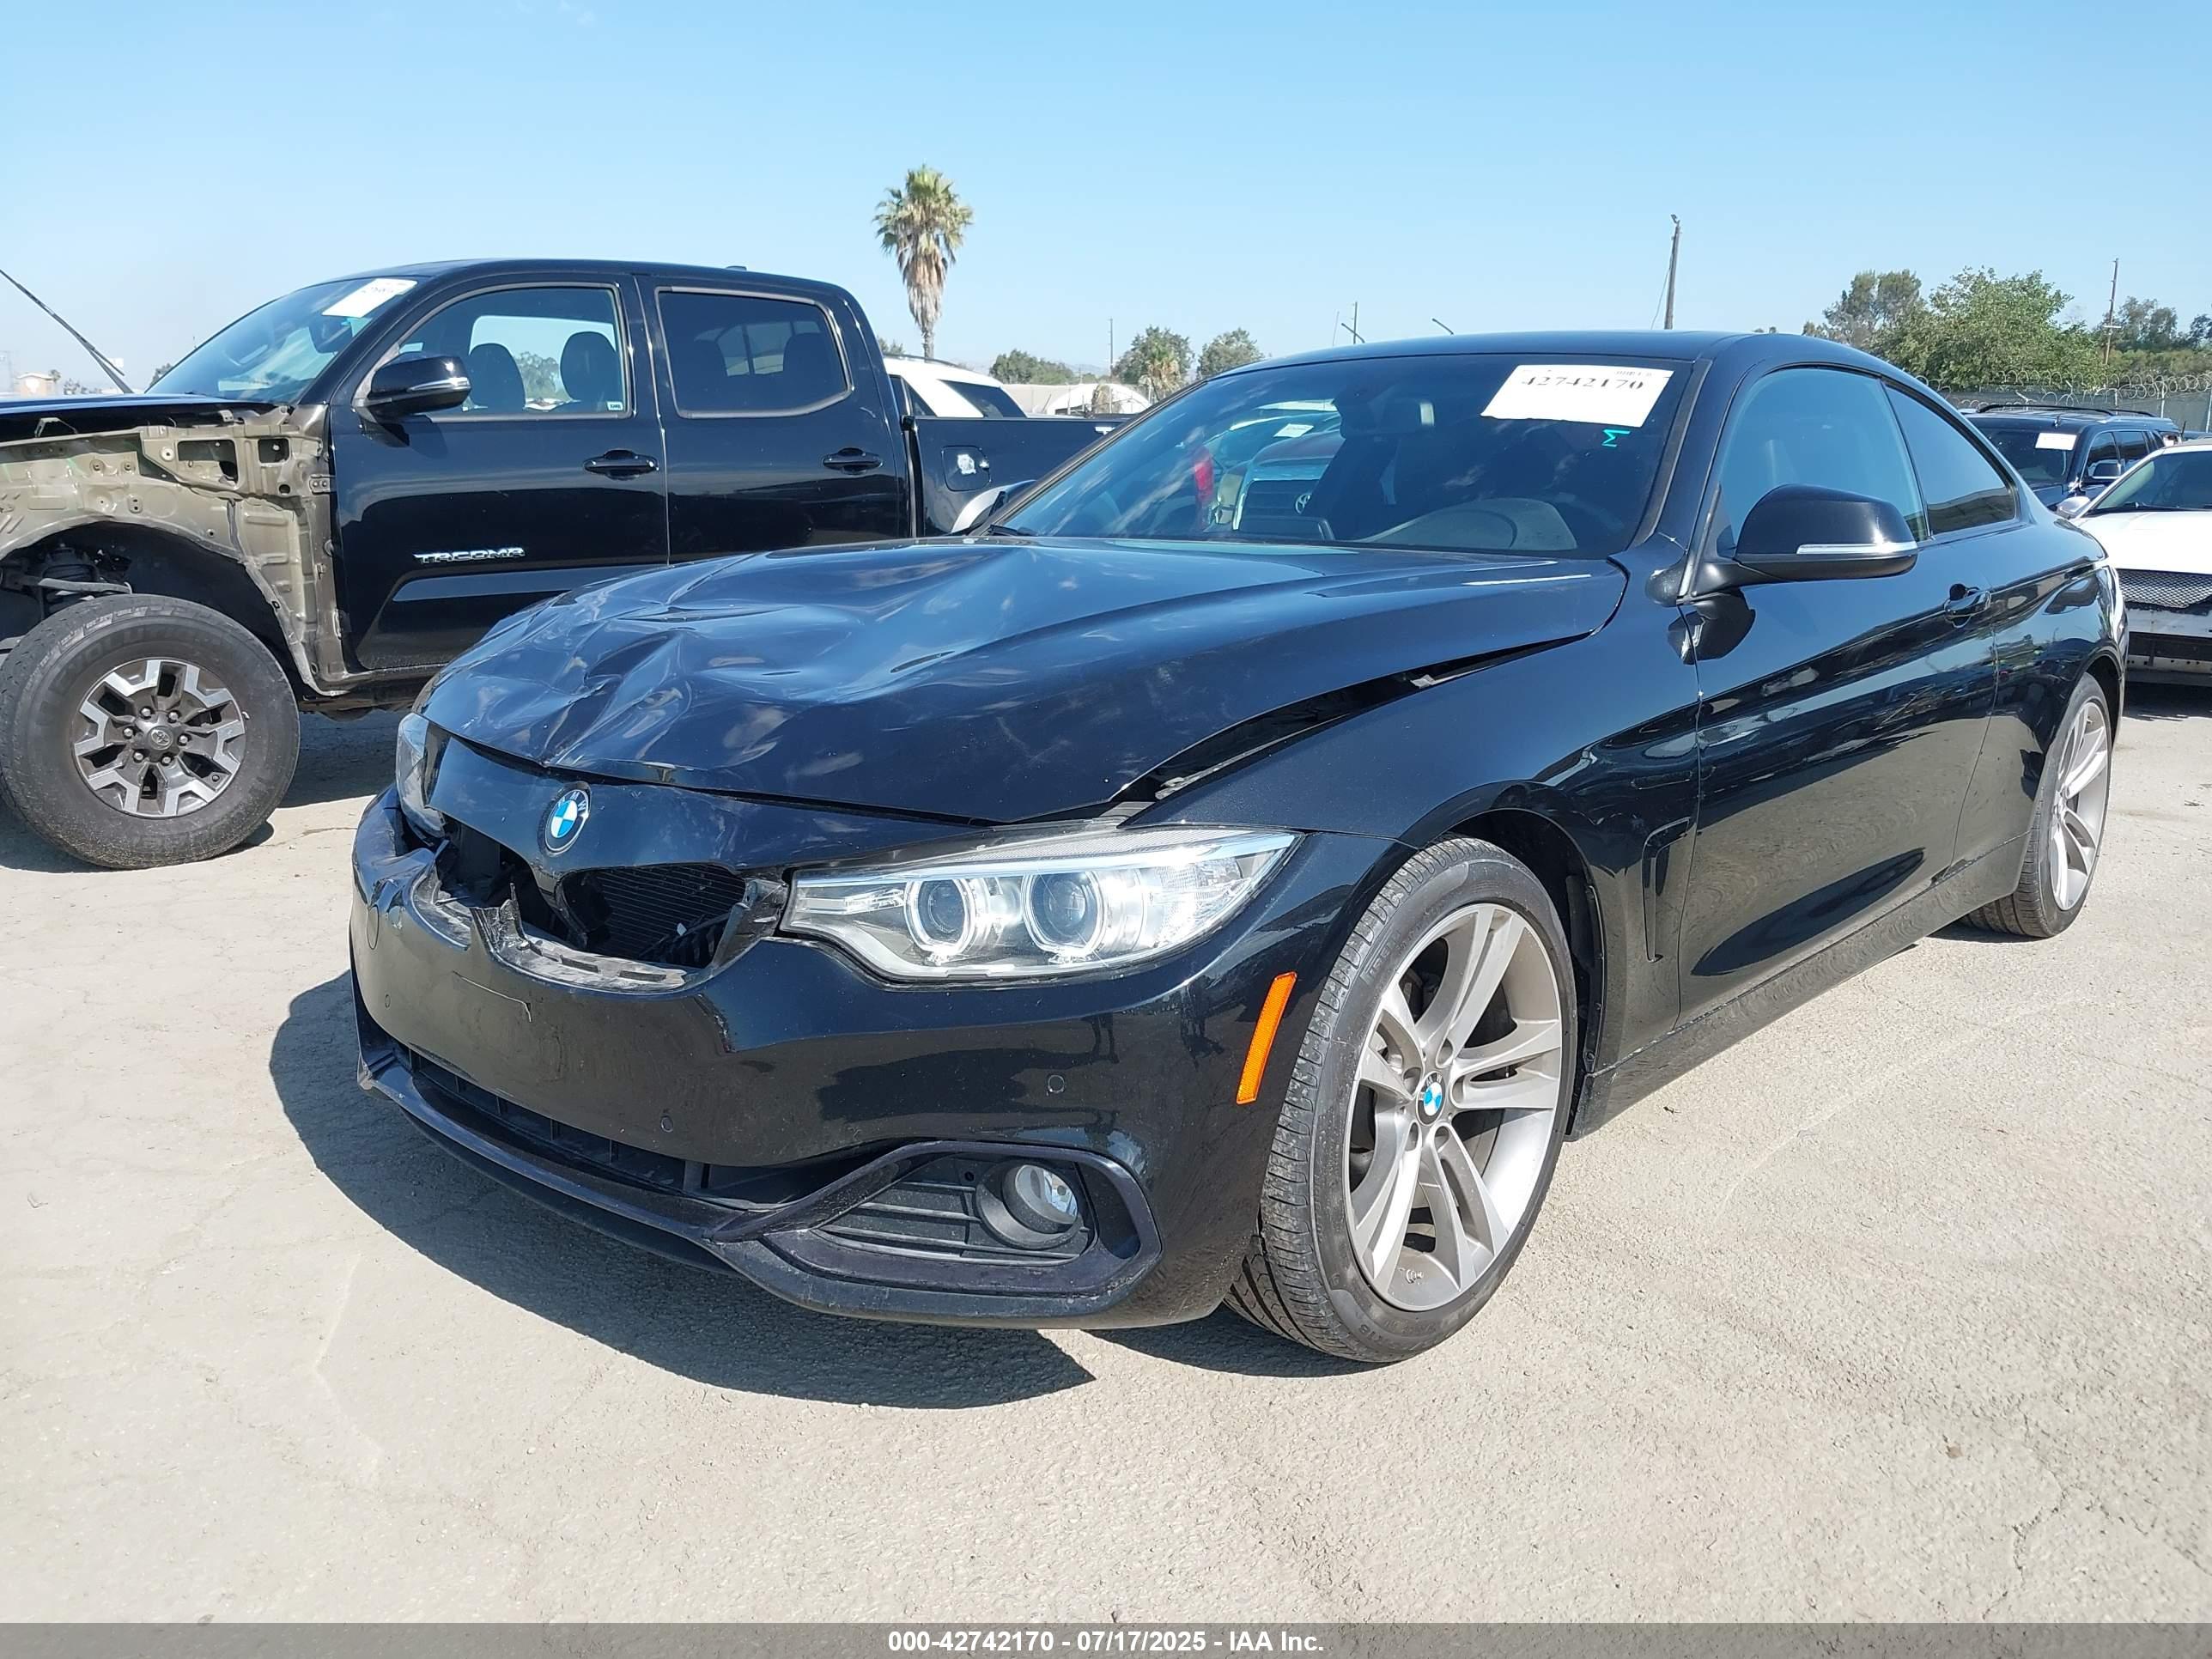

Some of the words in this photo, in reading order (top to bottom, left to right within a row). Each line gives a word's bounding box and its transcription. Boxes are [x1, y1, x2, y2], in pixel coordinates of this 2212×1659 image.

[412, 547, 526, 564] TACOMA
[557, 791, 587, 813] BMW
[1419, 1073, 1443, 1102] BMW
